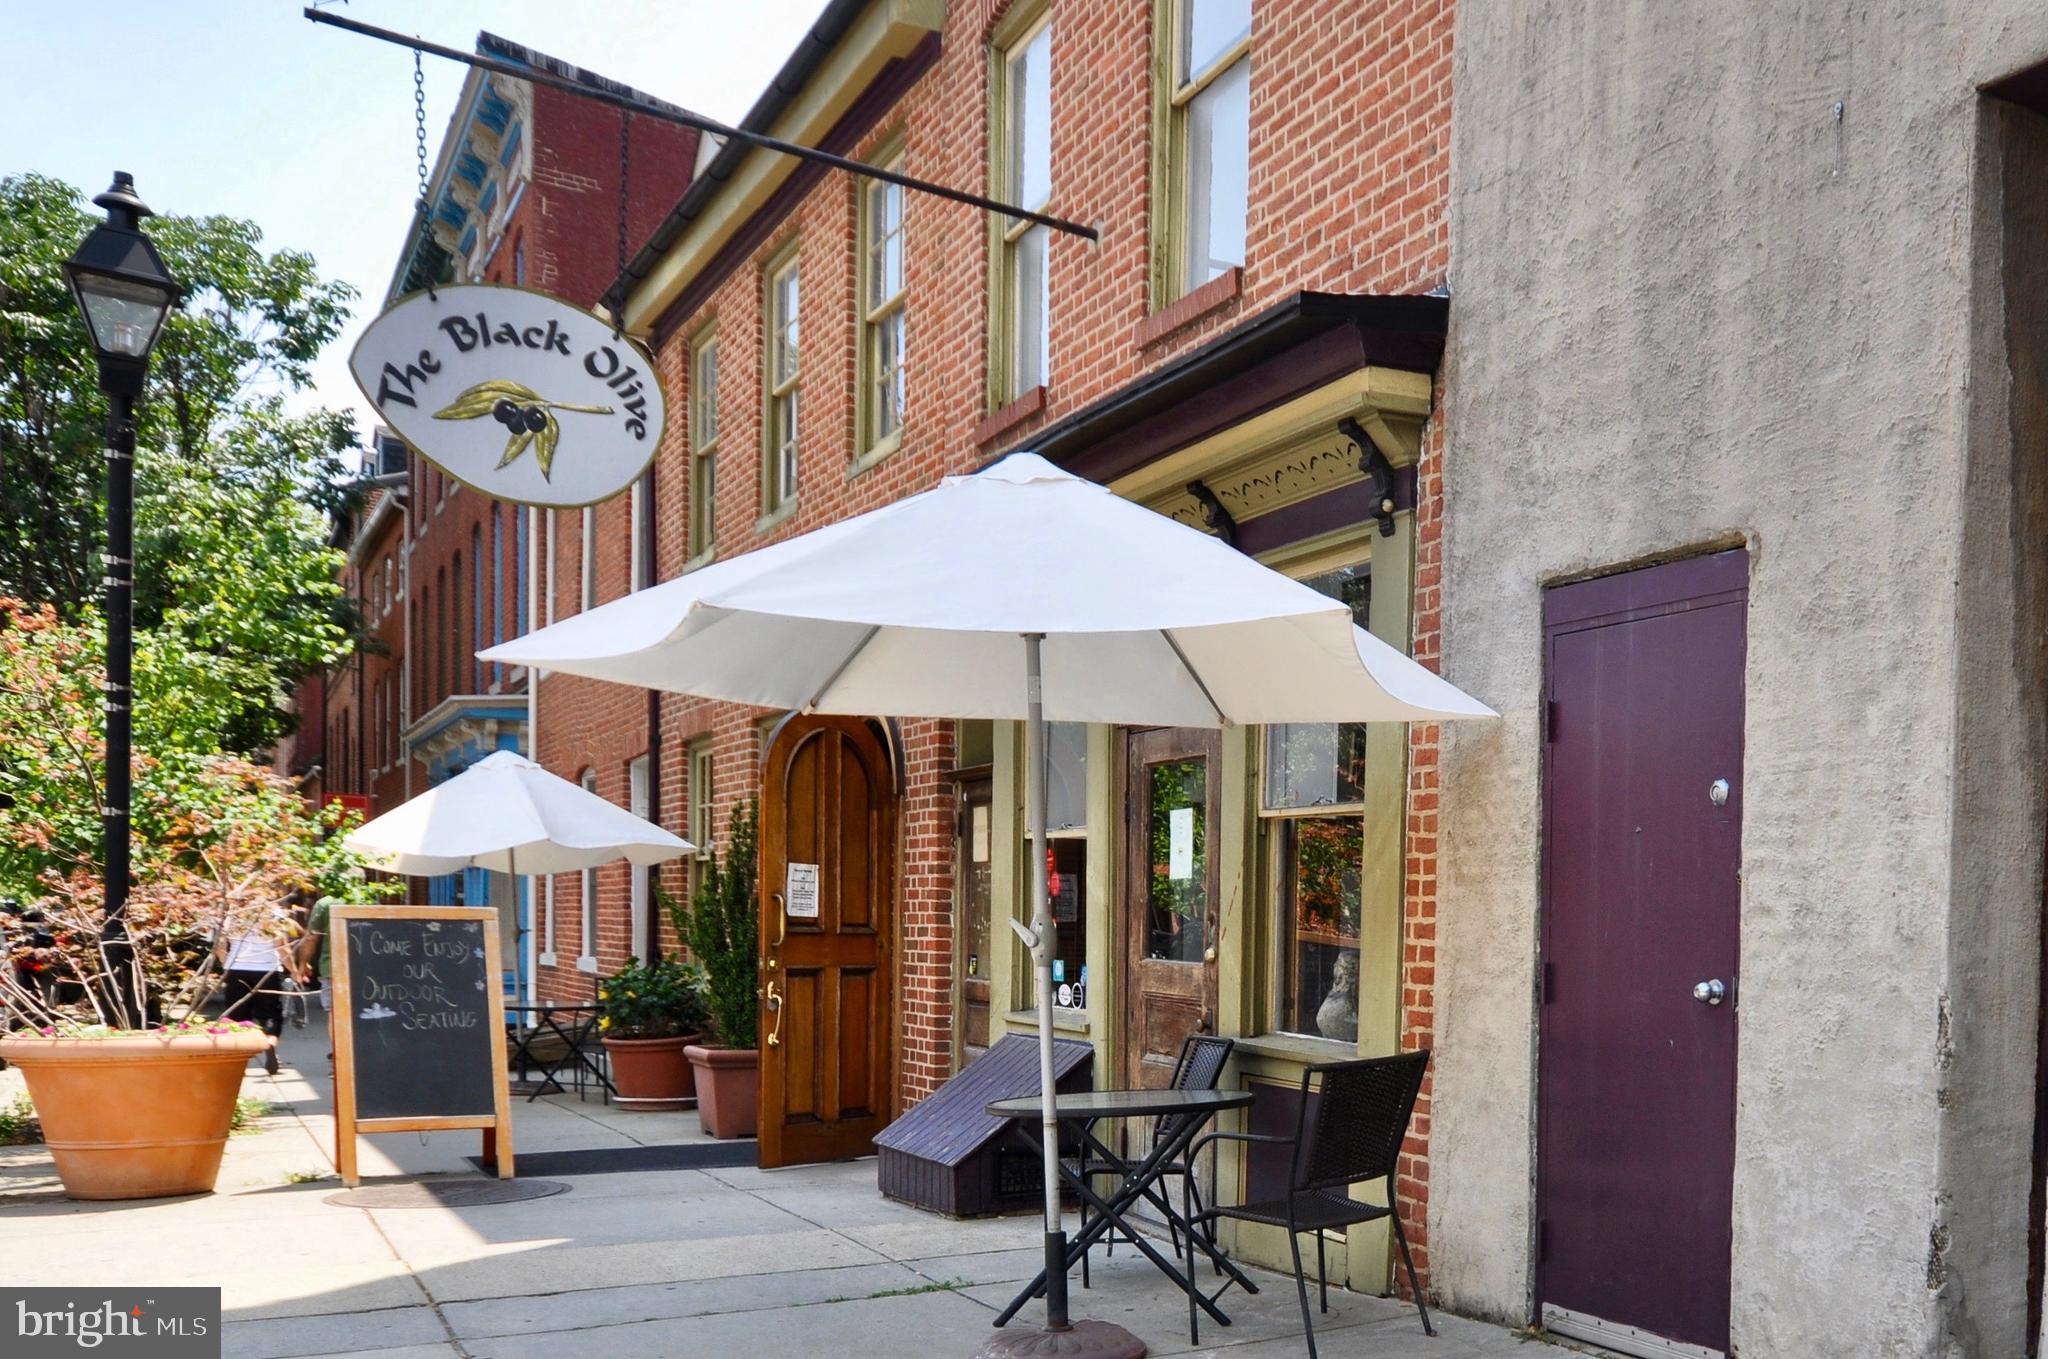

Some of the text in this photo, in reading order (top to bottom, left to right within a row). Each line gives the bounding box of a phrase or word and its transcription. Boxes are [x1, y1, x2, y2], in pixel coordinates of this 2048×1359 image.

[376, 312, 648, 441] The Black Olive
